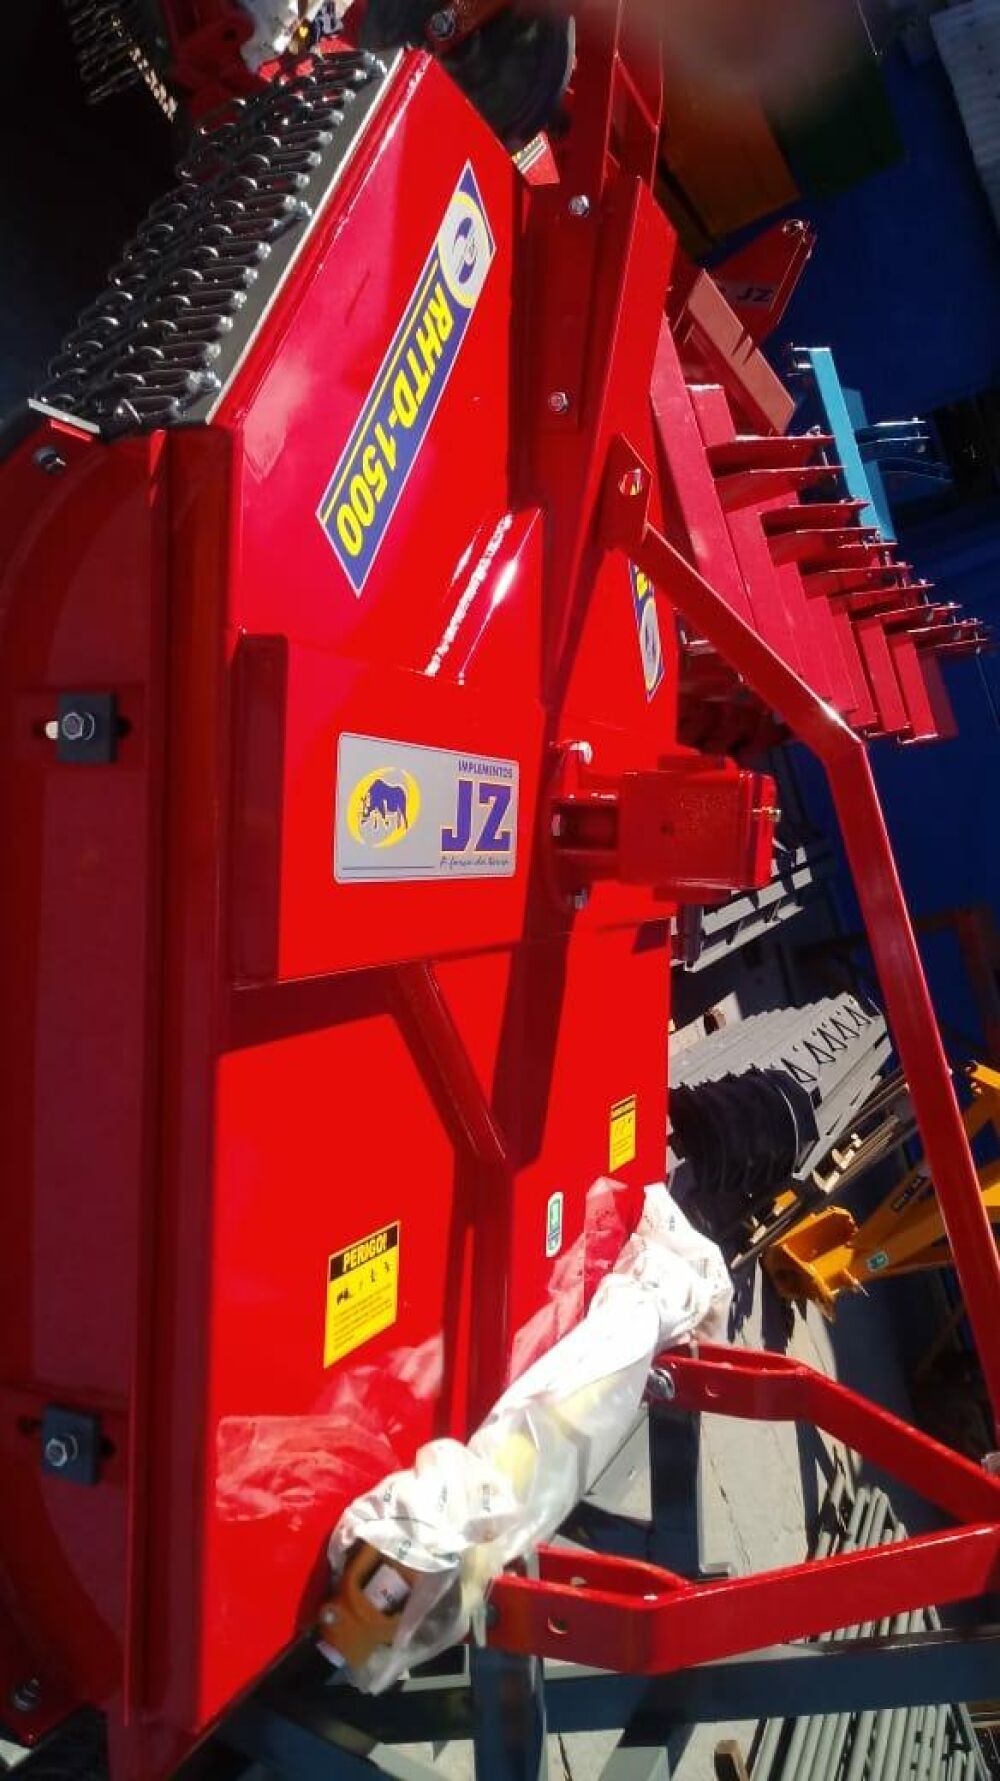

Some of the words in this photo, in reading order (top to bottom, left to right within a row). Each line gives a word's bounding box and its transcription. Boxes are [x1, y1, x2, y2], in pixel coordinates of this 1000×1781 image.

[336, 283, 456, 558] RHTD-1500
[458, 759, 513, 779] IMPLEMENTOS
[440, 778, 512, 853] JZ
[342, 1232, 388, 1273] PERIGO!
